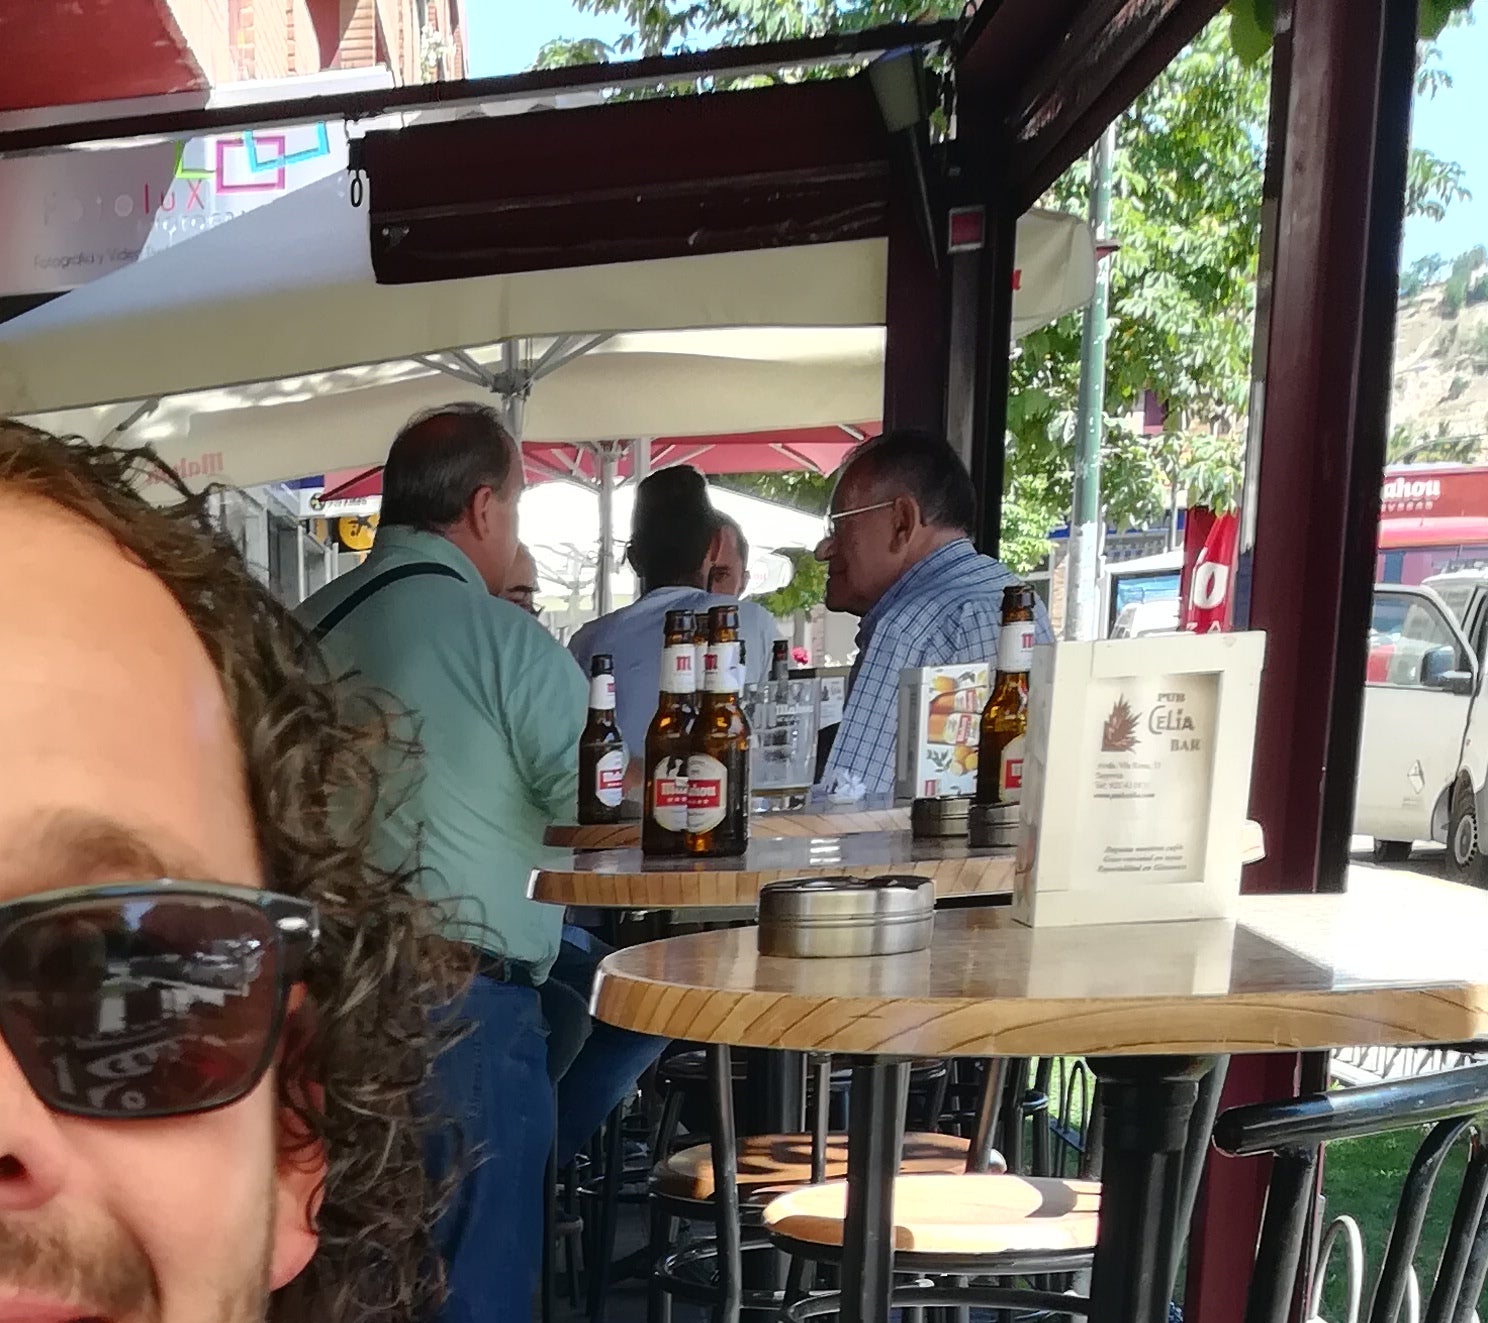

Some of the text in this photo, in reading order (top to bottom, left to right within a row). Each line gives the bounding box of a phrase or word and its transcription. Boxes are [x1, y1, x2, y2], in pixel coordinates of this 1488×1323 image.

[1380, 477, 1442, 500] ahou
[1157, 692, 1186, 703] PUB
[1170, 739, 1201, 752] BAR
